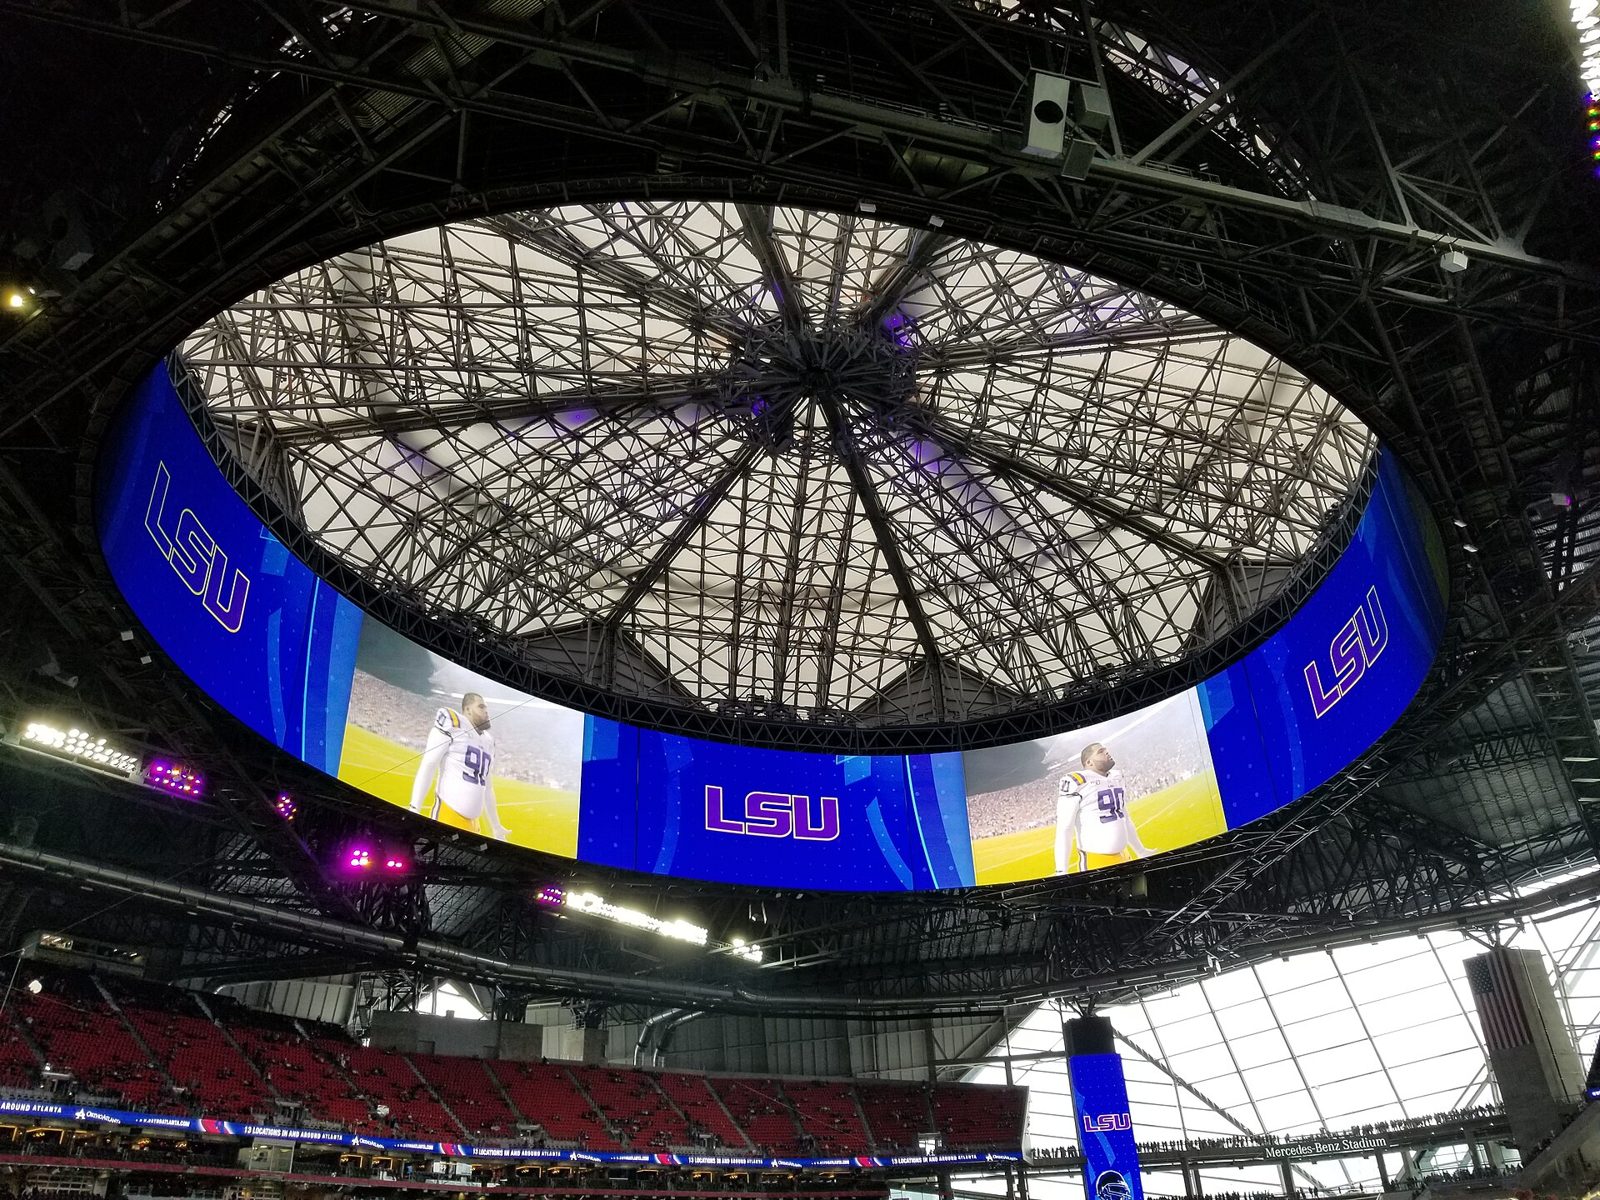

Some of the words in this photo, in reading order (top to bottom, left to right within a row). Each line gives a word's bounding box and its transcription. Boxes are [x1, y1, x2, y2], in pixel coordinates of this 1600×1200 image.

[145, 460, 250, 633] LSU
[1304, 585, 1389, 719] LSU
[705, 784, 840, 841] LSU
[0, 1102, 31, 1111] AROUND
[32, 1104, 62, 1113] ATLANTA
[1083, 1113, 1131, 1133] LSU
[252, 1127, 281, 1136] LOCATIONS
[288, 1129, 299, 1138] AND
[300, 1130, 321, 1139] AROUND
[322, 1132, 343, 1141] ATLANTA
[479, 1148, 503, 1156] LOCATIONS
[1265, 1142, 1341, 1158] Mercedes-Benz
[1343, 1137, 1386, 1150] Stadium
